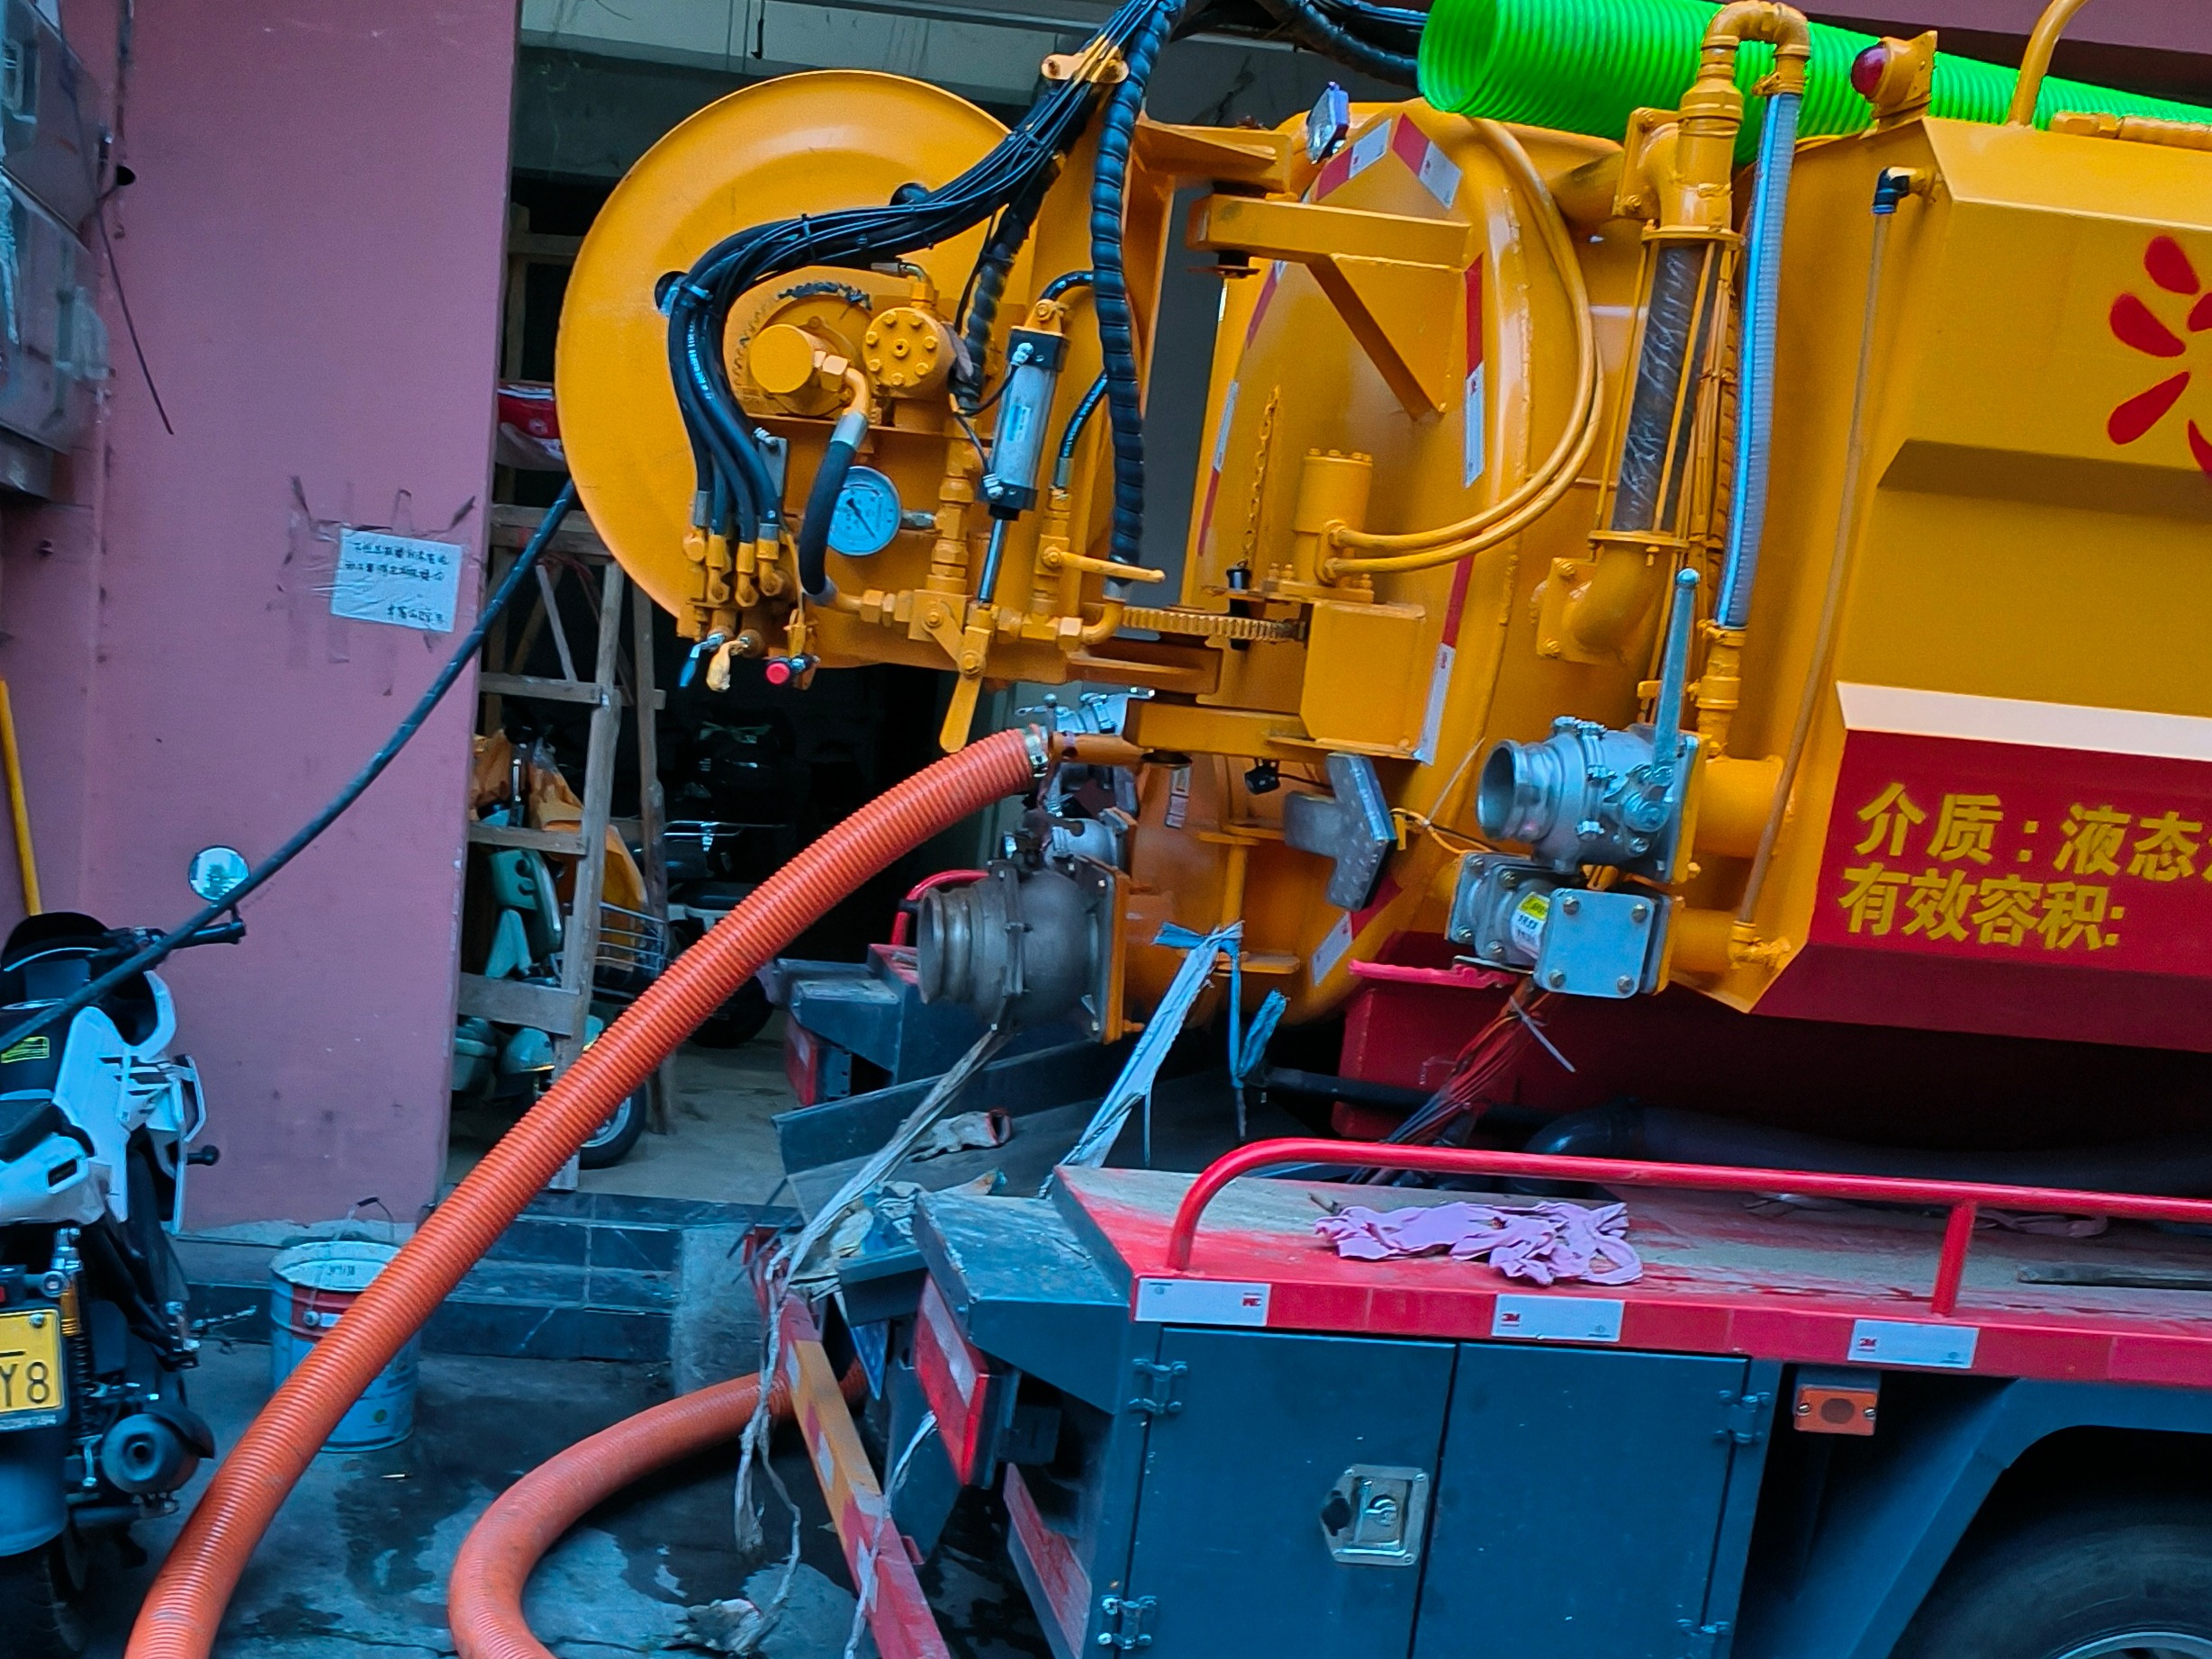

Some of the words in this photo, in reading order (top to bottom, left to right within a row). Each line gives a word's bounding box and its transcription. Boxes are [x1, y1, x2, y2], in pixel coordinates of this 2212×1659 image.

[1854, 781, 2212, 882] 介质：液态
[1839, 862, 2125, 950] 有效容积：
